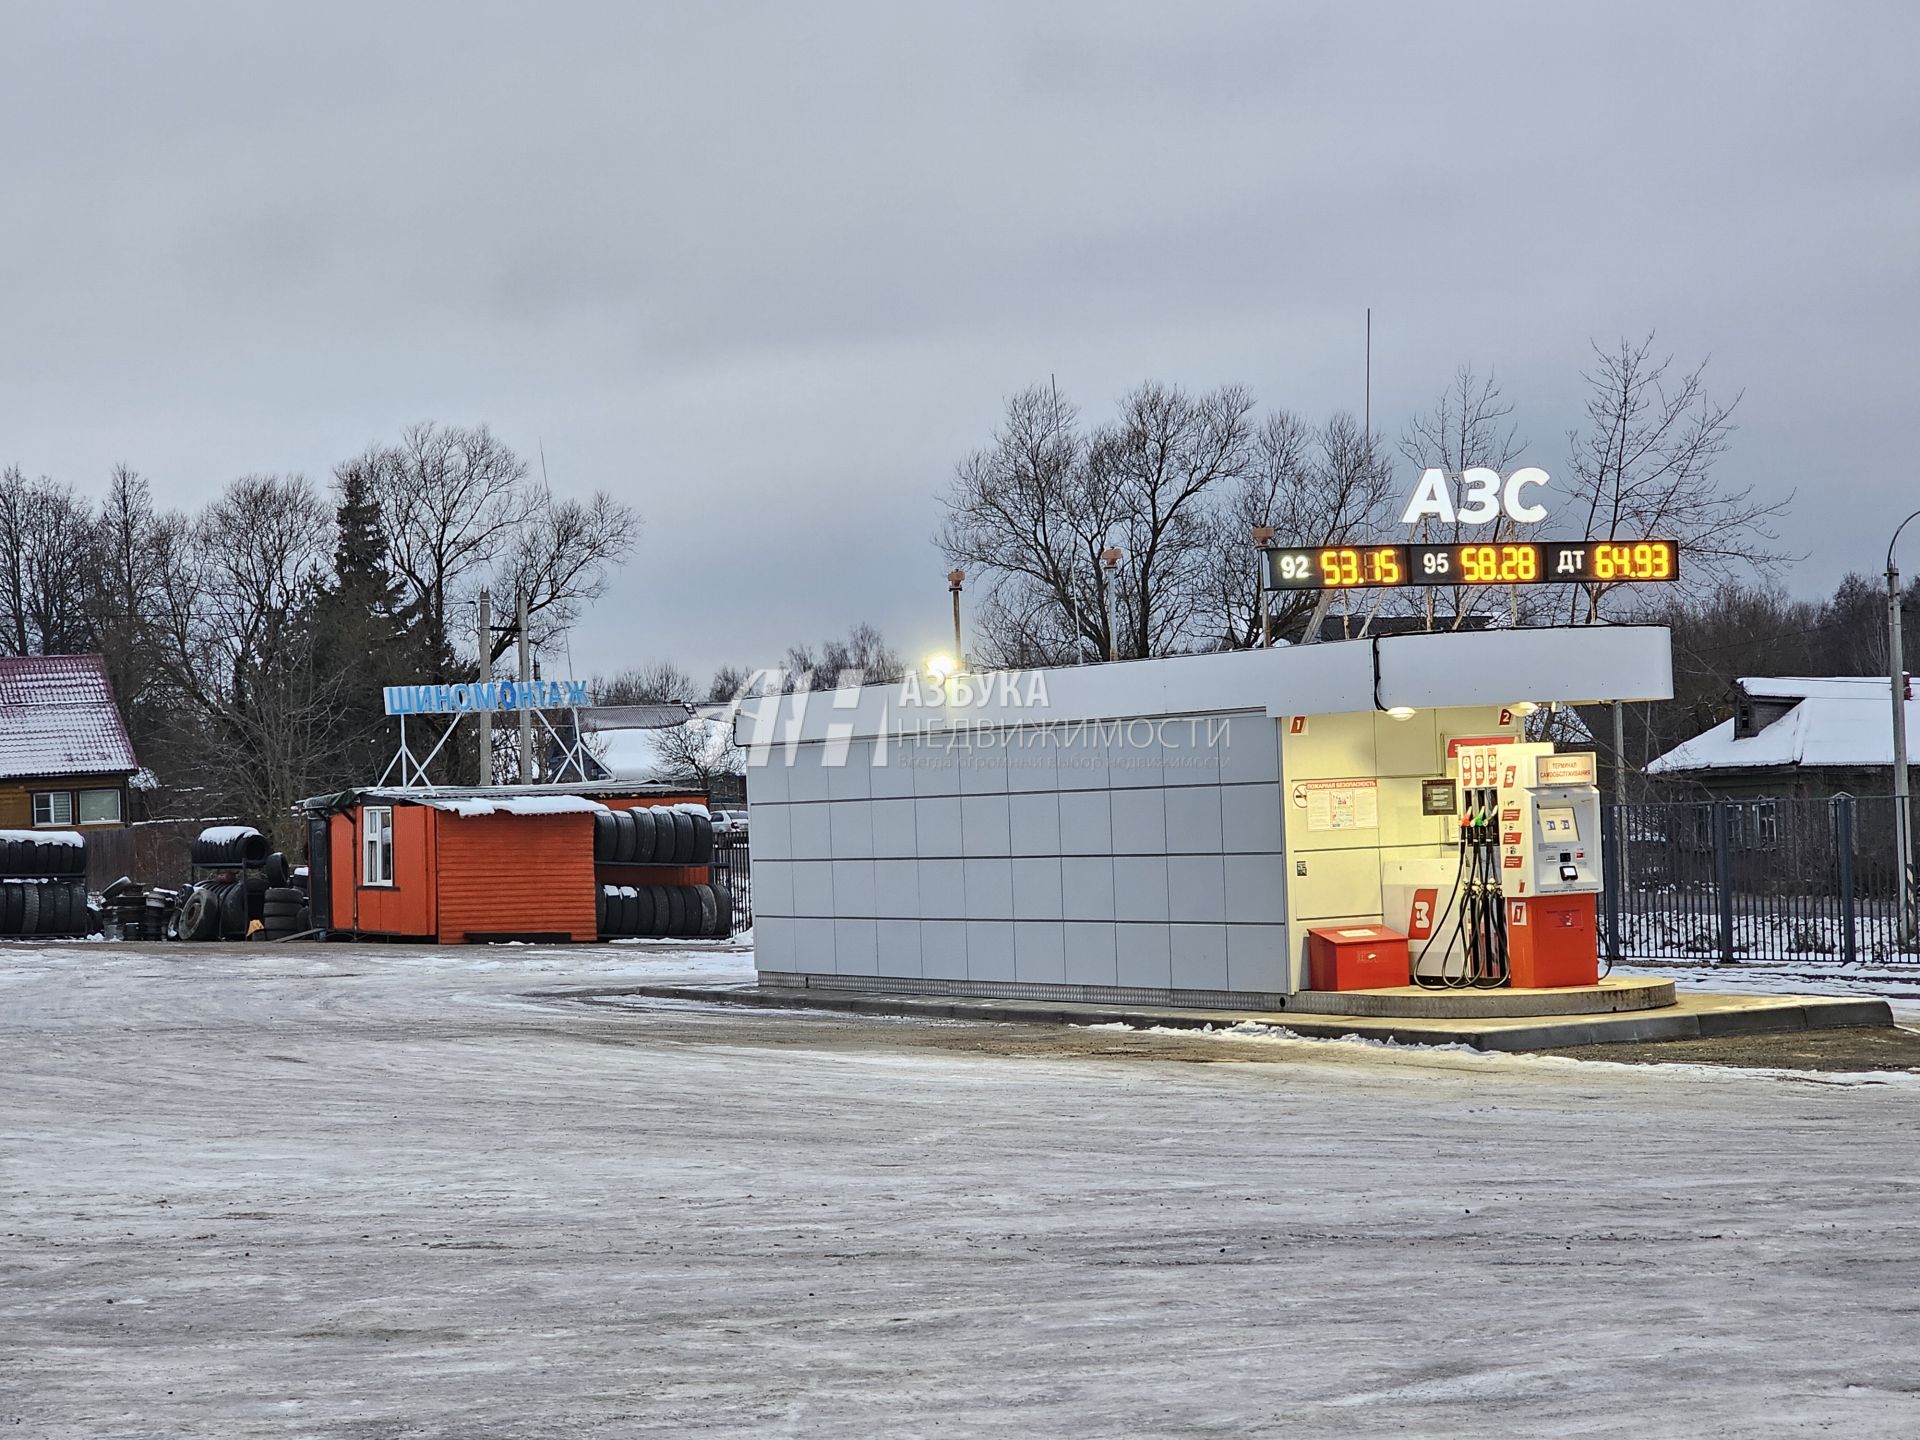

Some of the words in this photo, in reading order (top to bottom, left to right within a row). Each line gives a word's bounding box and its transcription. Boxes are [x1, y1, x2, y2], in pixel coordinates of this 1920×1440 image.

[1401, 467, 1551, 525] АЗС
[1281, 555, 1309, 579] 92
[1321, 549, 1399, 585] 53.15
[1423, 552, 1450, 574] 95
[1461, 547, 1536, 581] 58.28
[1557, 550, 1585, 573] ДТ
[1595, 544, 1669, 578] 64.93
[384, 680, 591, 714] ШИНОМОНТАЖ
[1506, 771, 1513, 783] 3
